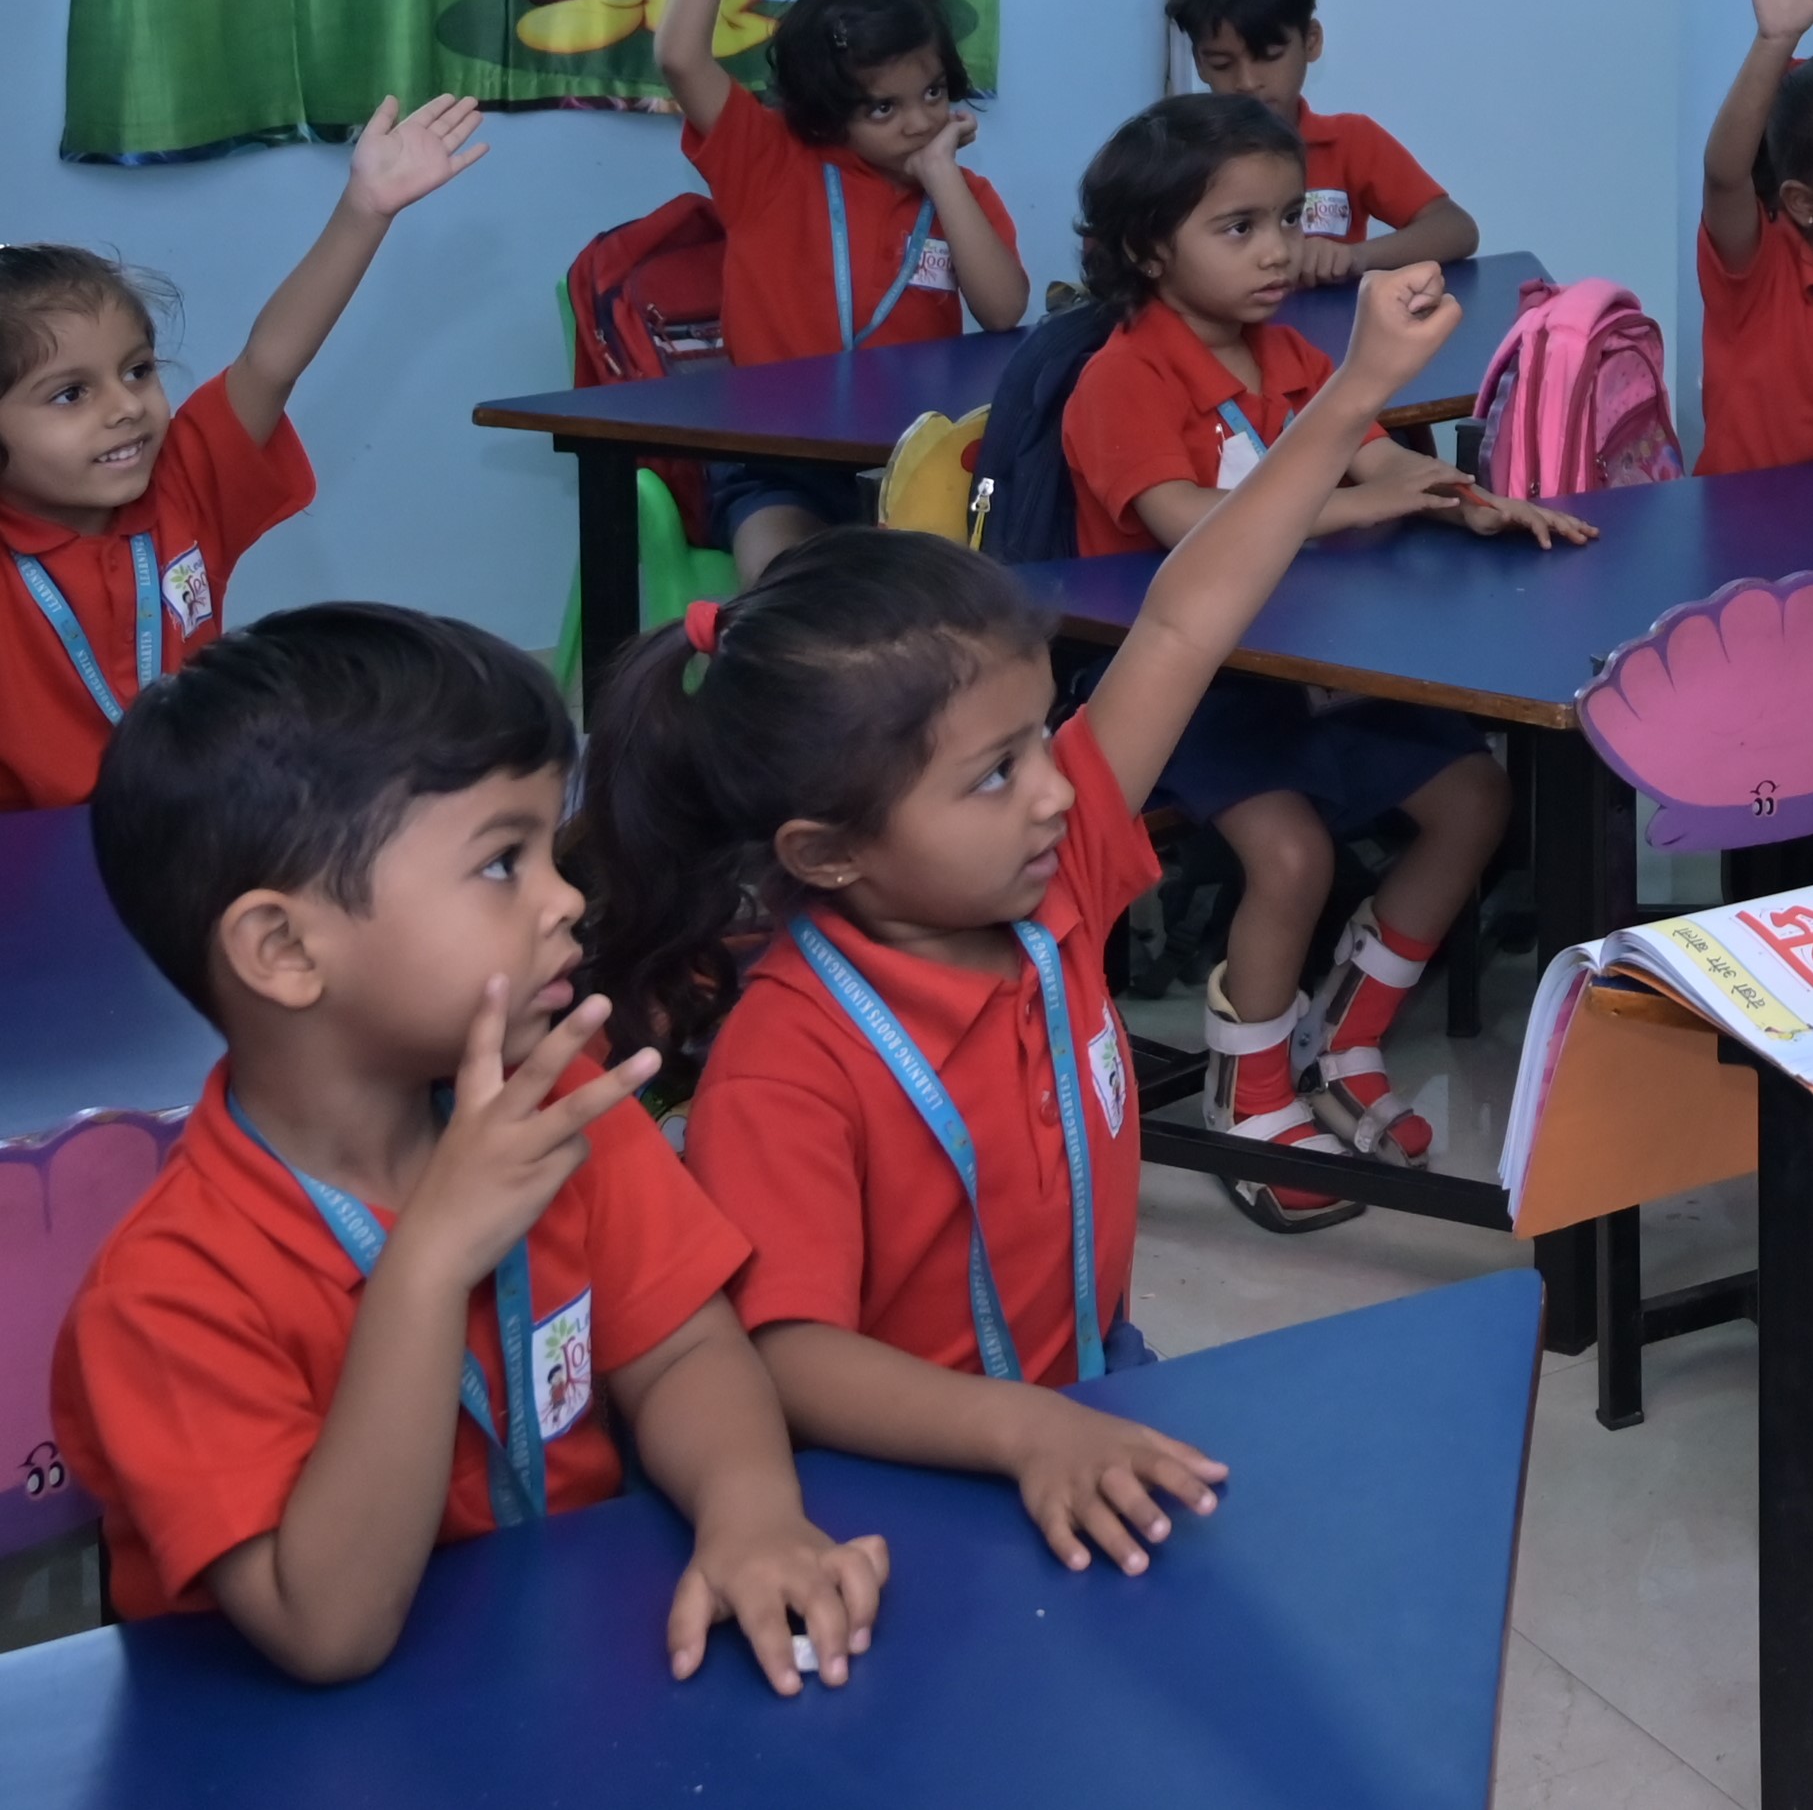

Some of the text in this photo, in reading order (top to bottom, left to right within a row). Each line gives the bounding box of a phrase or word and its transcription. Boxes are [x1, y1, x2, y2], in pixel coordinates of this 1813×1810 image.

[799, 928, 944, 1112] LEARNING ROOTS KINDERGARTEN
